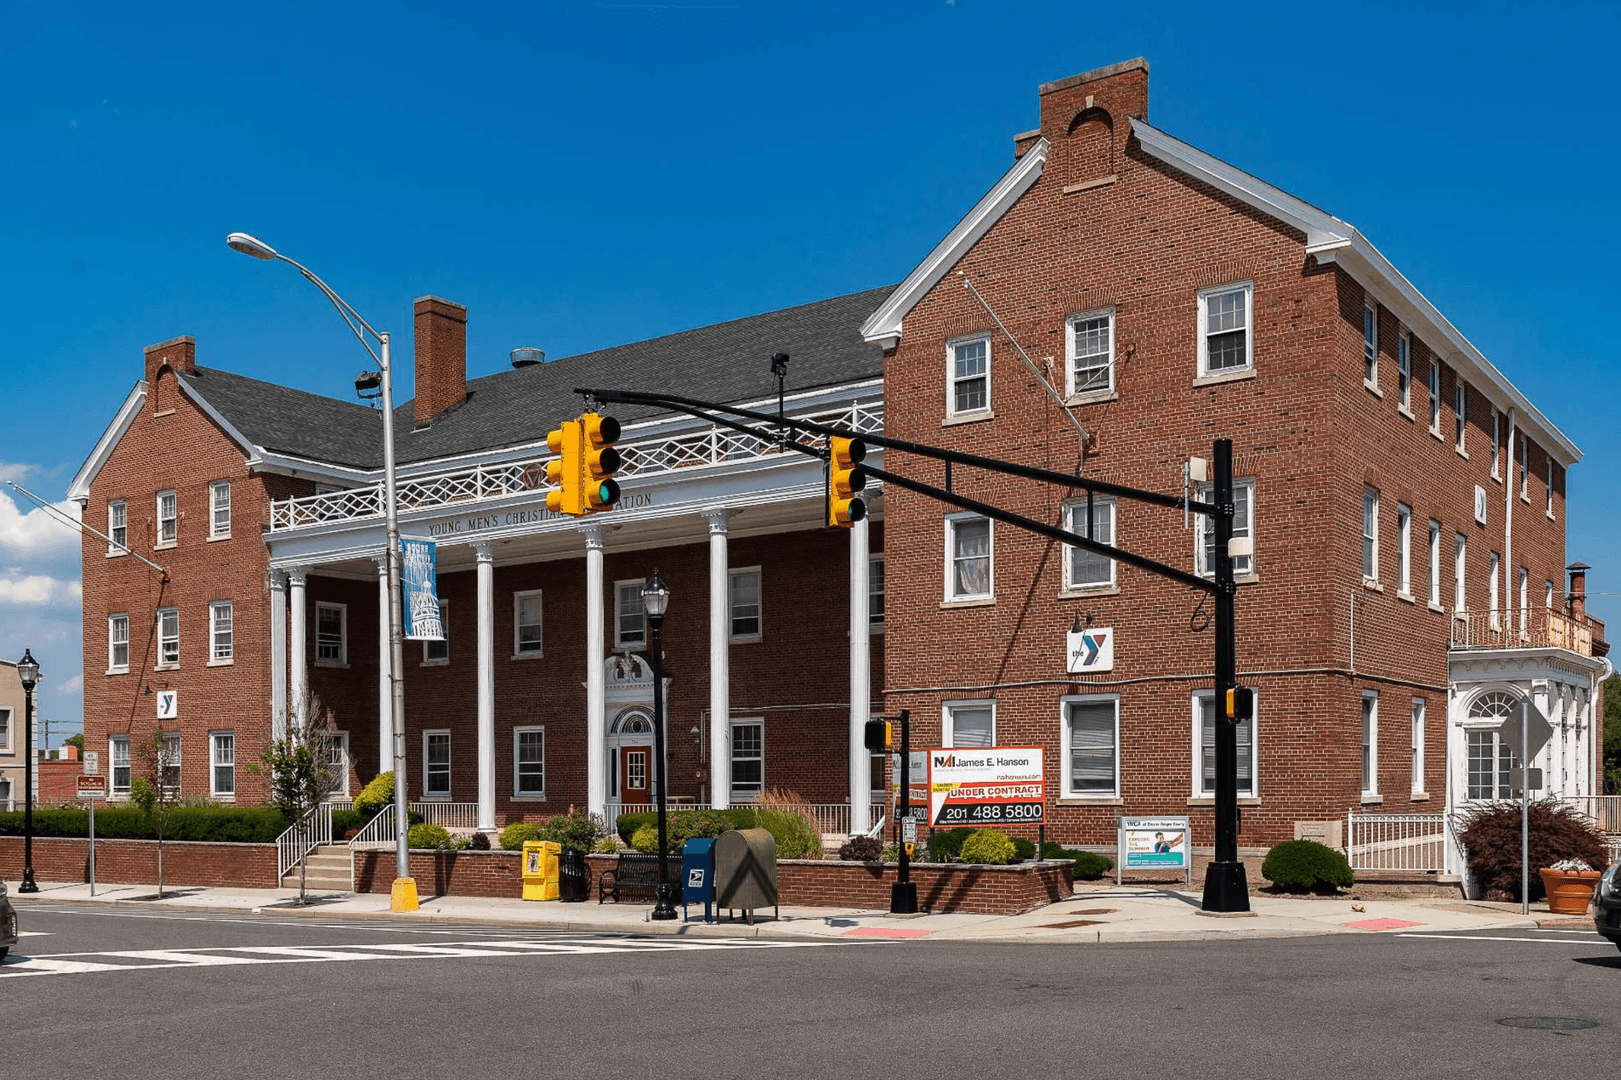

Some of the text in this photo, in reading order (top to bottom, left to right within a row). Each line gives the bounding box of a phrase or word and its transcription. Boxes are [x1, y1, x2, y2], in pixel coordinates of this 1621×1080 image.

[429, 521, 461, 537] YOUNG
[468, 514, 499, 530] MEN'S
[934, 754, 1029, 768] NAI James E. Hanson
[950, 785, 1041, 797] UNDER CONTRACT
[946, 804, 1042, 819] 201 488 5800
